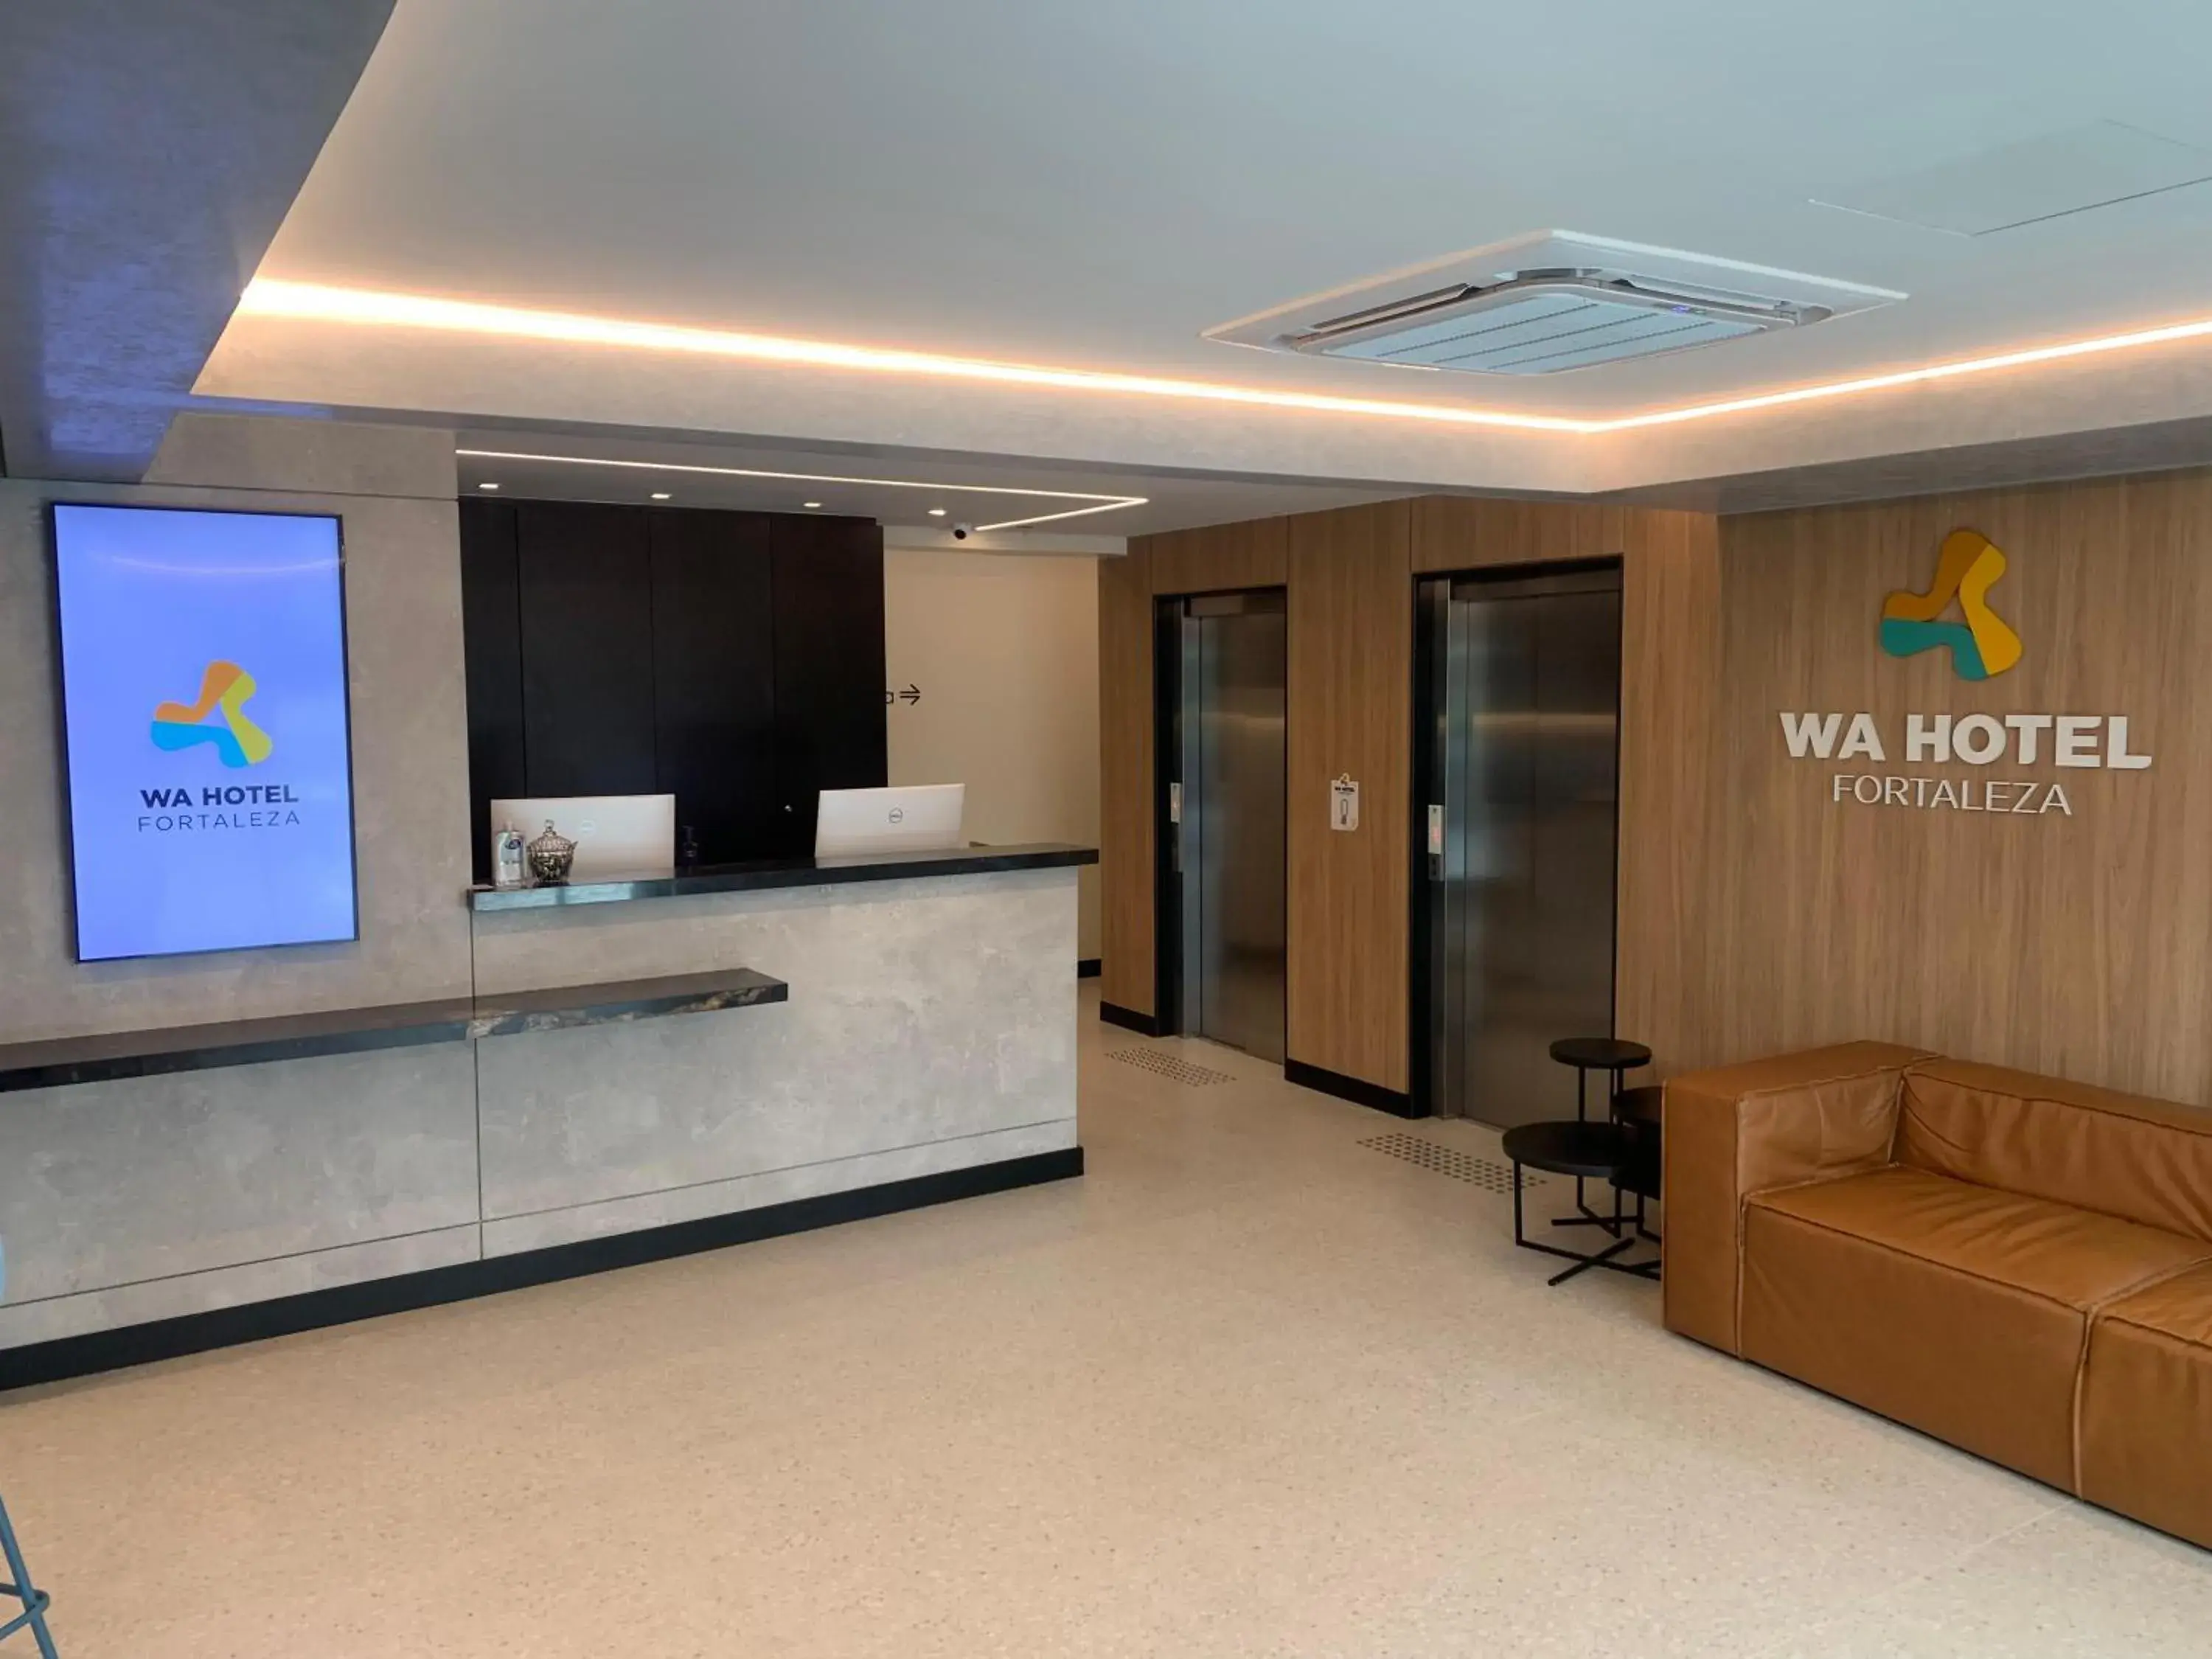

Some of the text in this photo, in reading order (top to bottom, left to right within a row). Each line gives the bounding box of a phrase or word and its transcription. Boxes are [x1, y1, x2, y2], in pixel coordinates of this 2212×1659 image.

[1778, 712, 2152, 769] WA HOTEL
[140, 785, 299, 808] WA HOTEL
[1834, 775, 2072, 815] FORTALEZA
[138, 810, 300, 832] FORTALEZA
